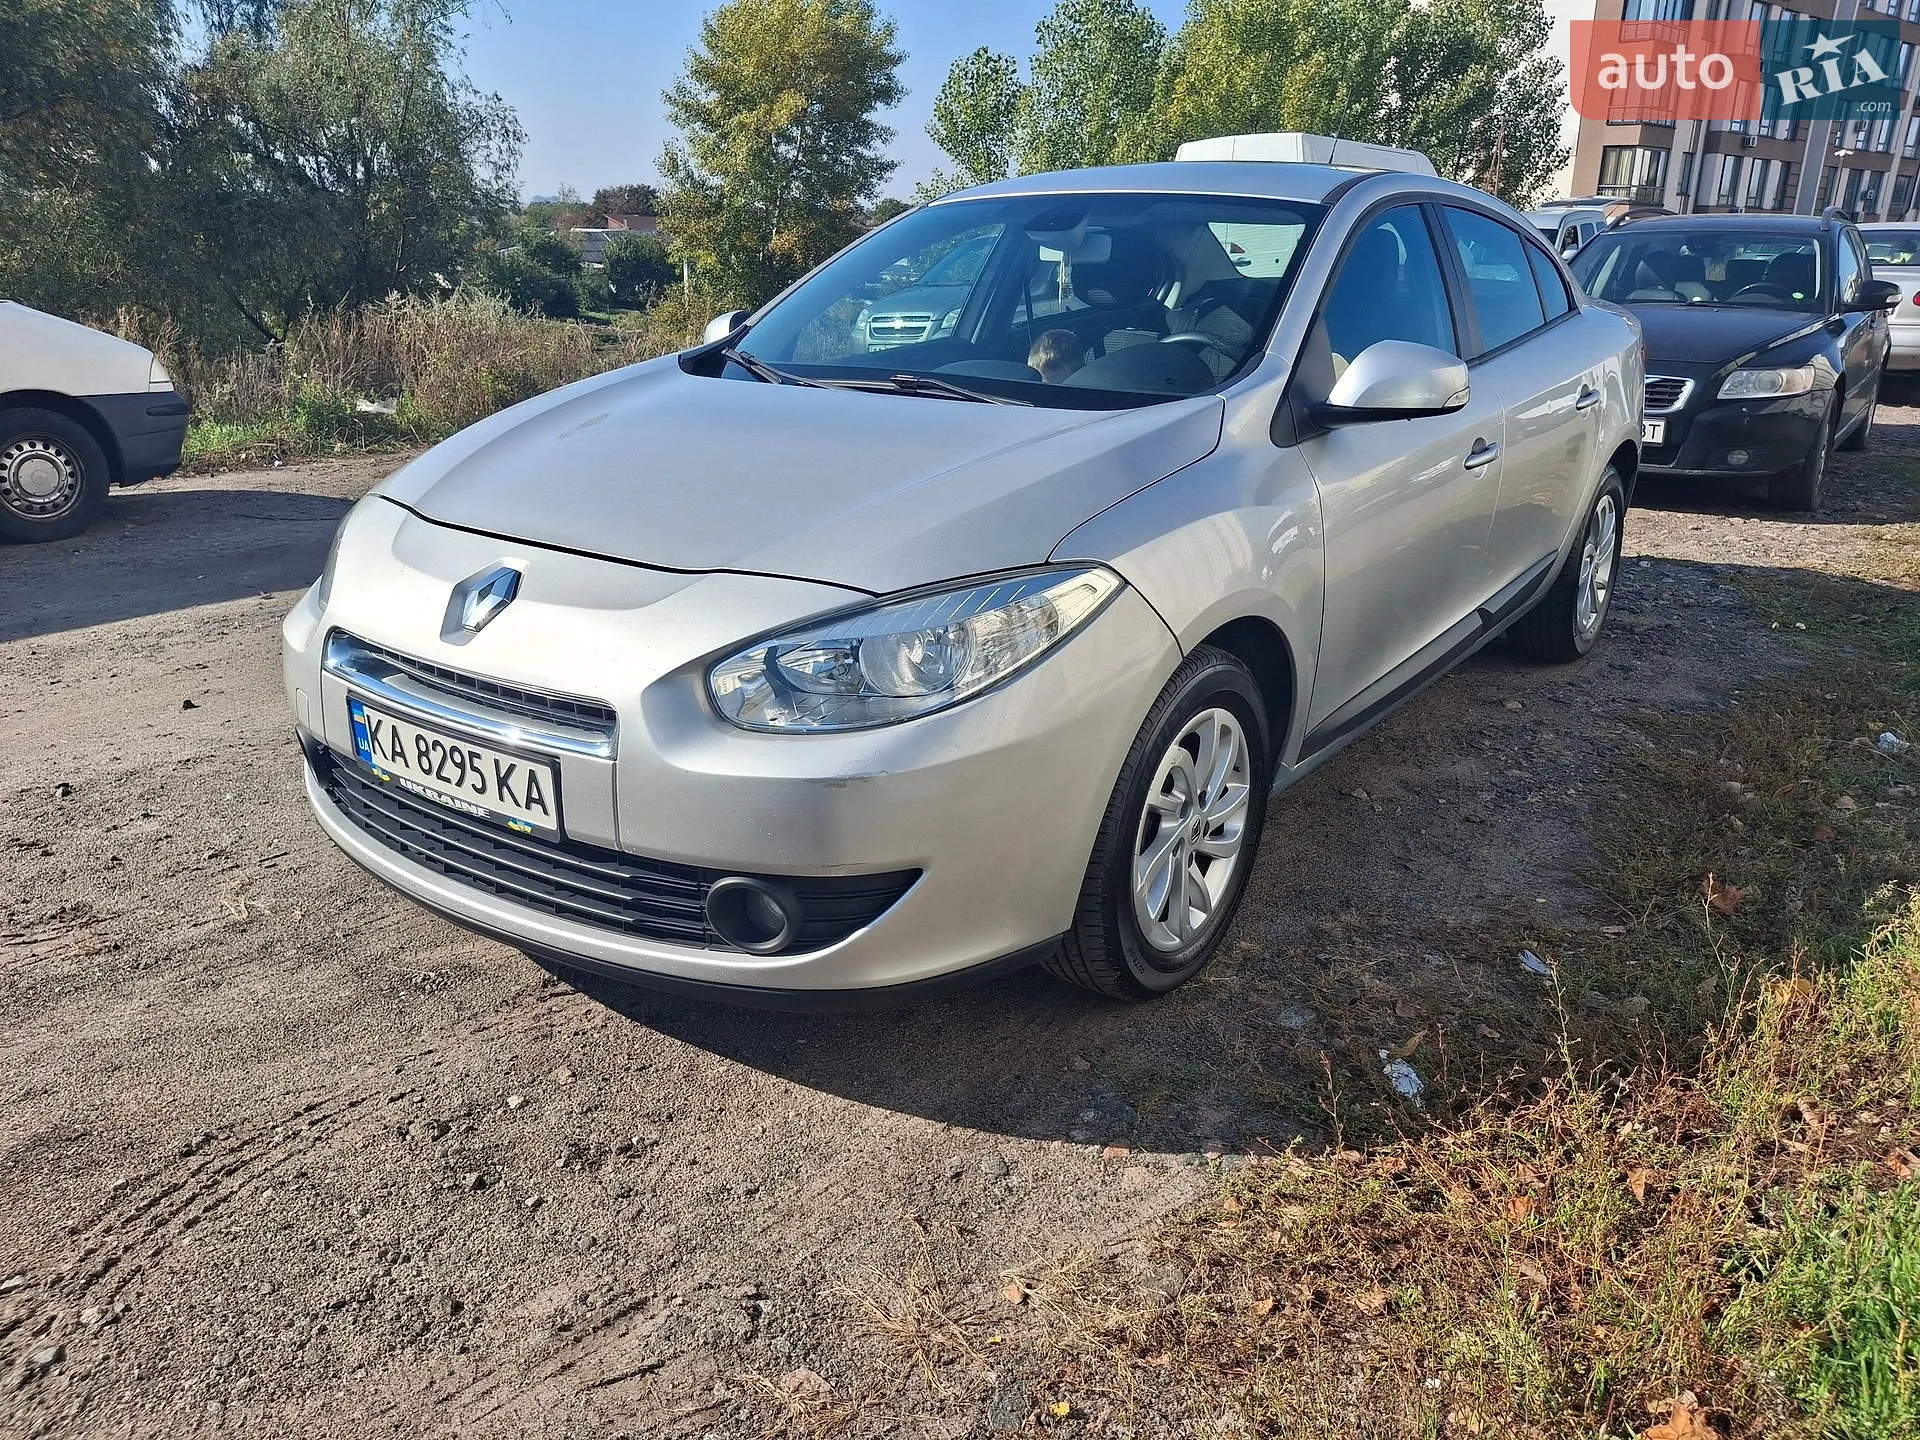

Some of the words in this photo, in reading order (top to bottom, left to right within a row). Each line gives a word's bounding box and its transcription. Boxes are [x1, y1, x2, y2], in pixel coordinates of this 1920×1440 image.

[358, 737, 371, 752] UA
[366, 714, 411, 769] KA
[415, 734, 487, 795] 8295
[493, 758, 549, 817] KA
[399, 777, 491, 819] UKRAINE
